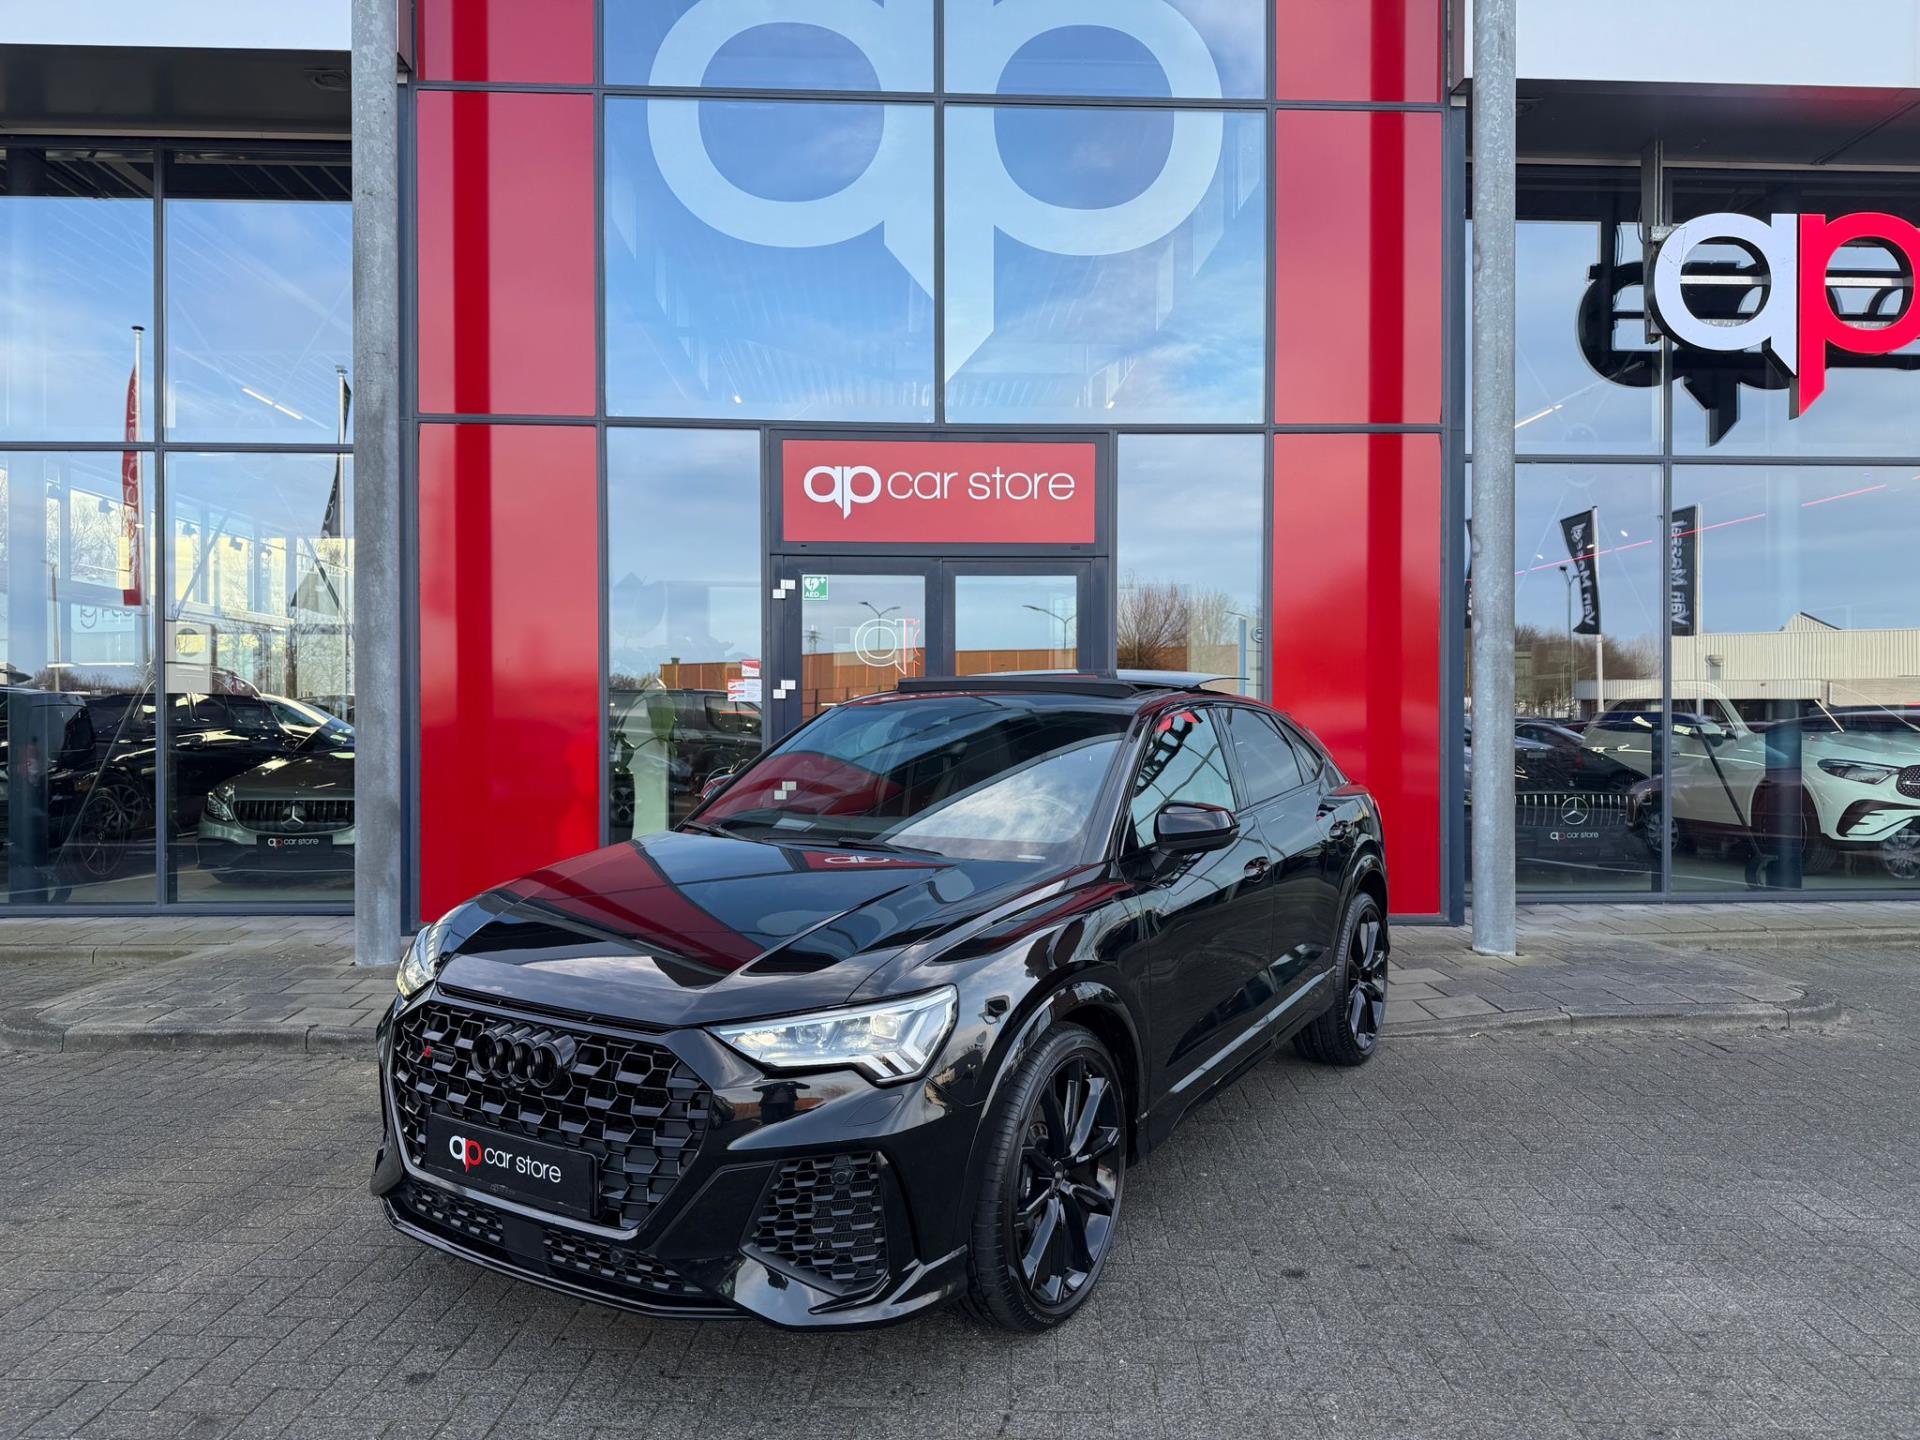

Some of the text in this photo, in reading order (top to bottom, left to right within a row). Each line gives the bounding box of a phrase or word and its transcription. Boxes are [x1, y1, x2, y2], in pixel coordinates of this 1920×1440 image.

[1653, 211, 1920, 418] ap
[803, 465, 1075, 520] ap car store
[449, 1135, 561, 1183] ap car store
